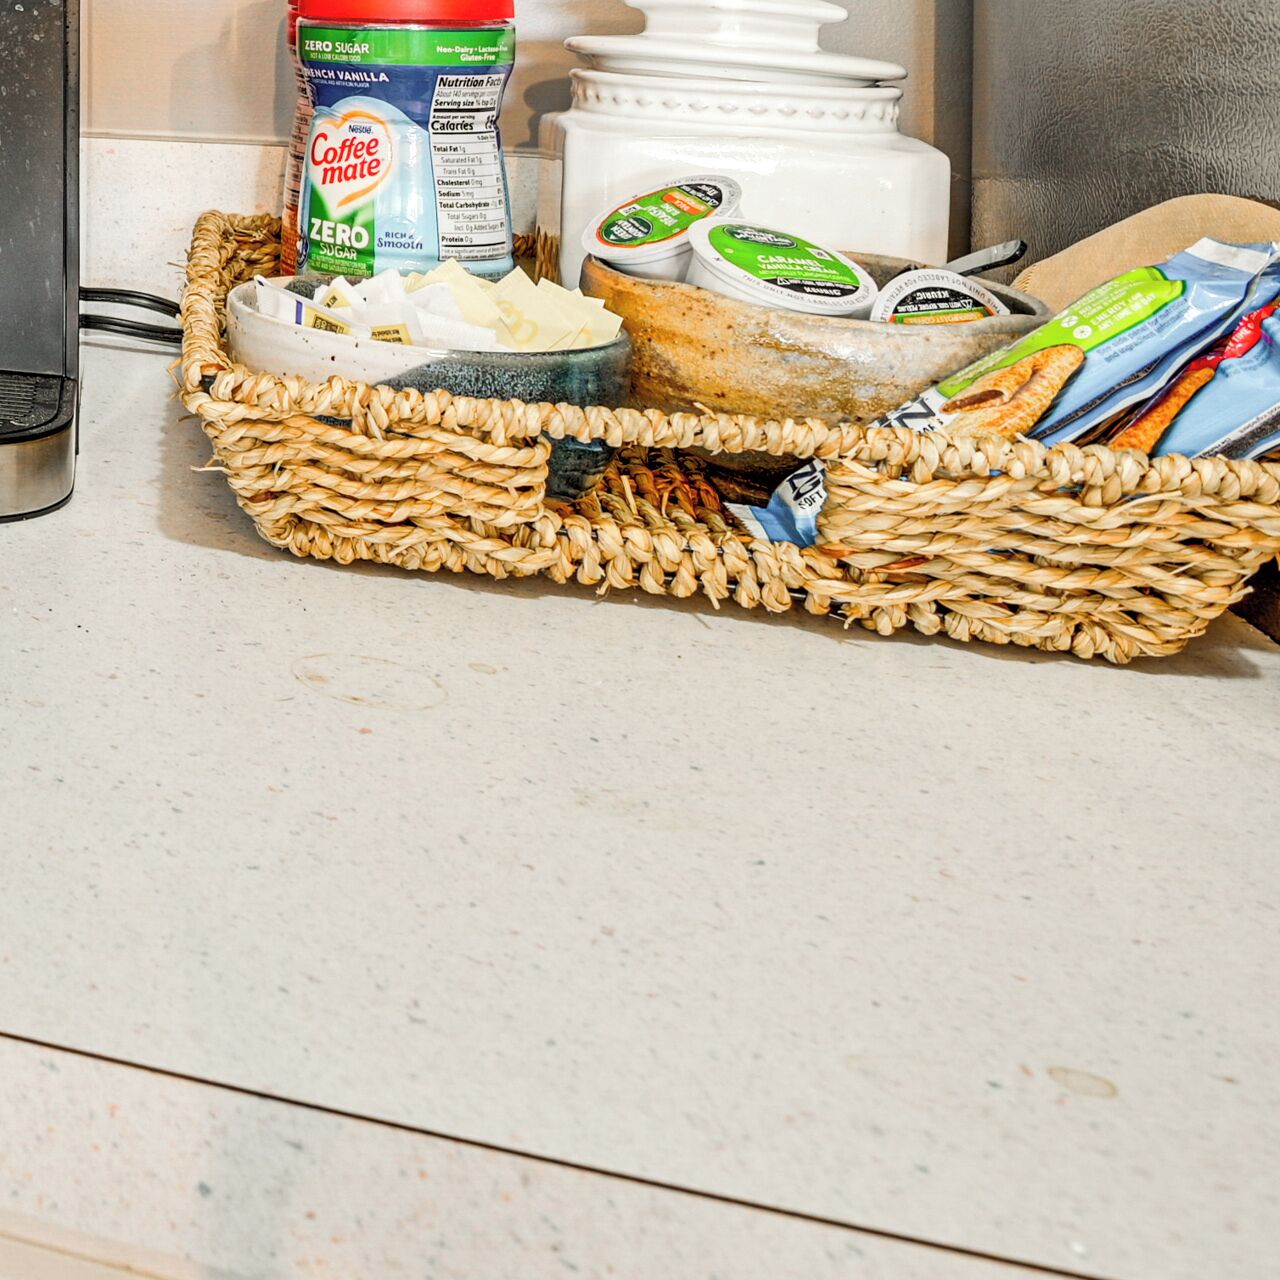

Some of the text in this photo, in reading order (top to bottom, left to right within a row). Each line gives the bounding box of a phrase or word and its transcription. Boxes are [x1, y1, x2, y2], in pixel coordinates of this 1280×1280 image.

[304, 40, 370, 54] ZERO SUGAR
[336, 70, 390, 83] VANILLA
[438, 76, 502, 87] Nutrition Facts
[434, 99, 460, 109] Serving
[431, 120, 474, 131] Calories
[311, 132, 379, 166] Coffee
[321, 157, 381, 185] mate
[456, 202, 490, 210] Carbohydrate
[461, 213, 479, 221] Sugars
[310, 218, 370, 249] ZERO
[385, 231, 407, 239] RICH
[320, 243, 358, 260] SUGAR
[757, 255, 824, 268] CARAMEL
[917, 274, 949, 283] LABELED
[951, 277, 967, 286] NOT
[803, 286, 841, 296] KEURIG
[916, 290, 950, 300] KEURIG
[968, 283, 986, 298] UNIT
